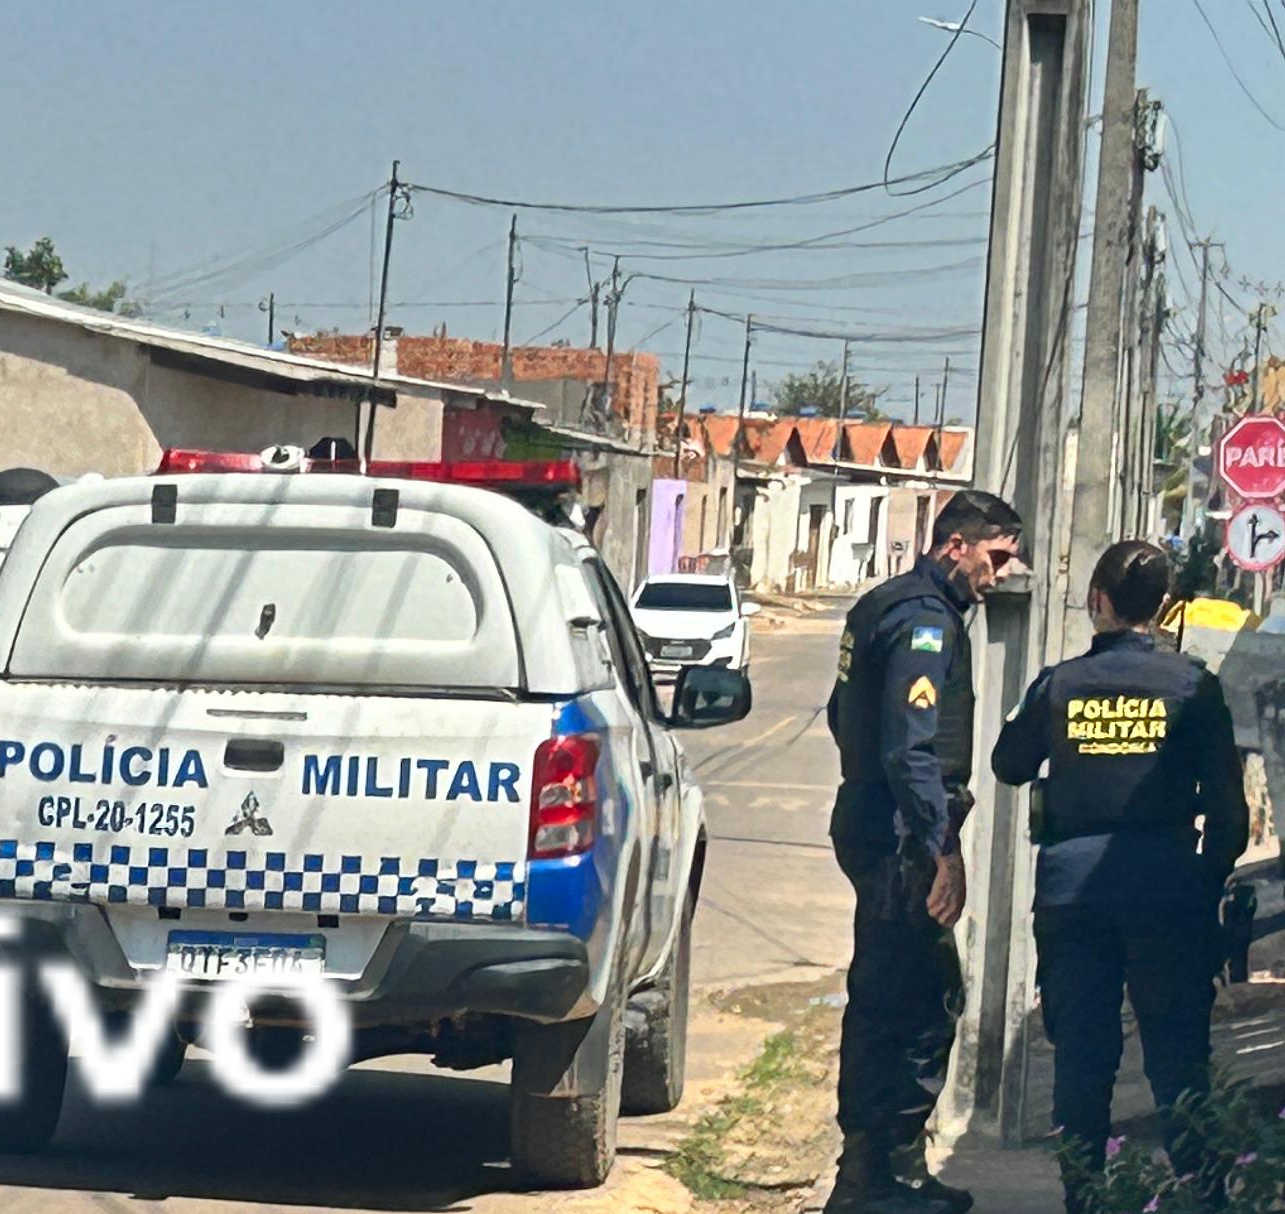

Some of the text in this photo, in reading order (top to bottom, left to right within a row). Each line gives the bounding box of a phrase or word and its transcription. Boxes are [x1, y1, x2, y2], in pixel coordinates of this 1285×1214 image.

[1067, 695, 1167, 719] POLÍCIA
[1067, 720, 1167, 740] MILITAR
[301, 753, 522, 804] MILITAR
